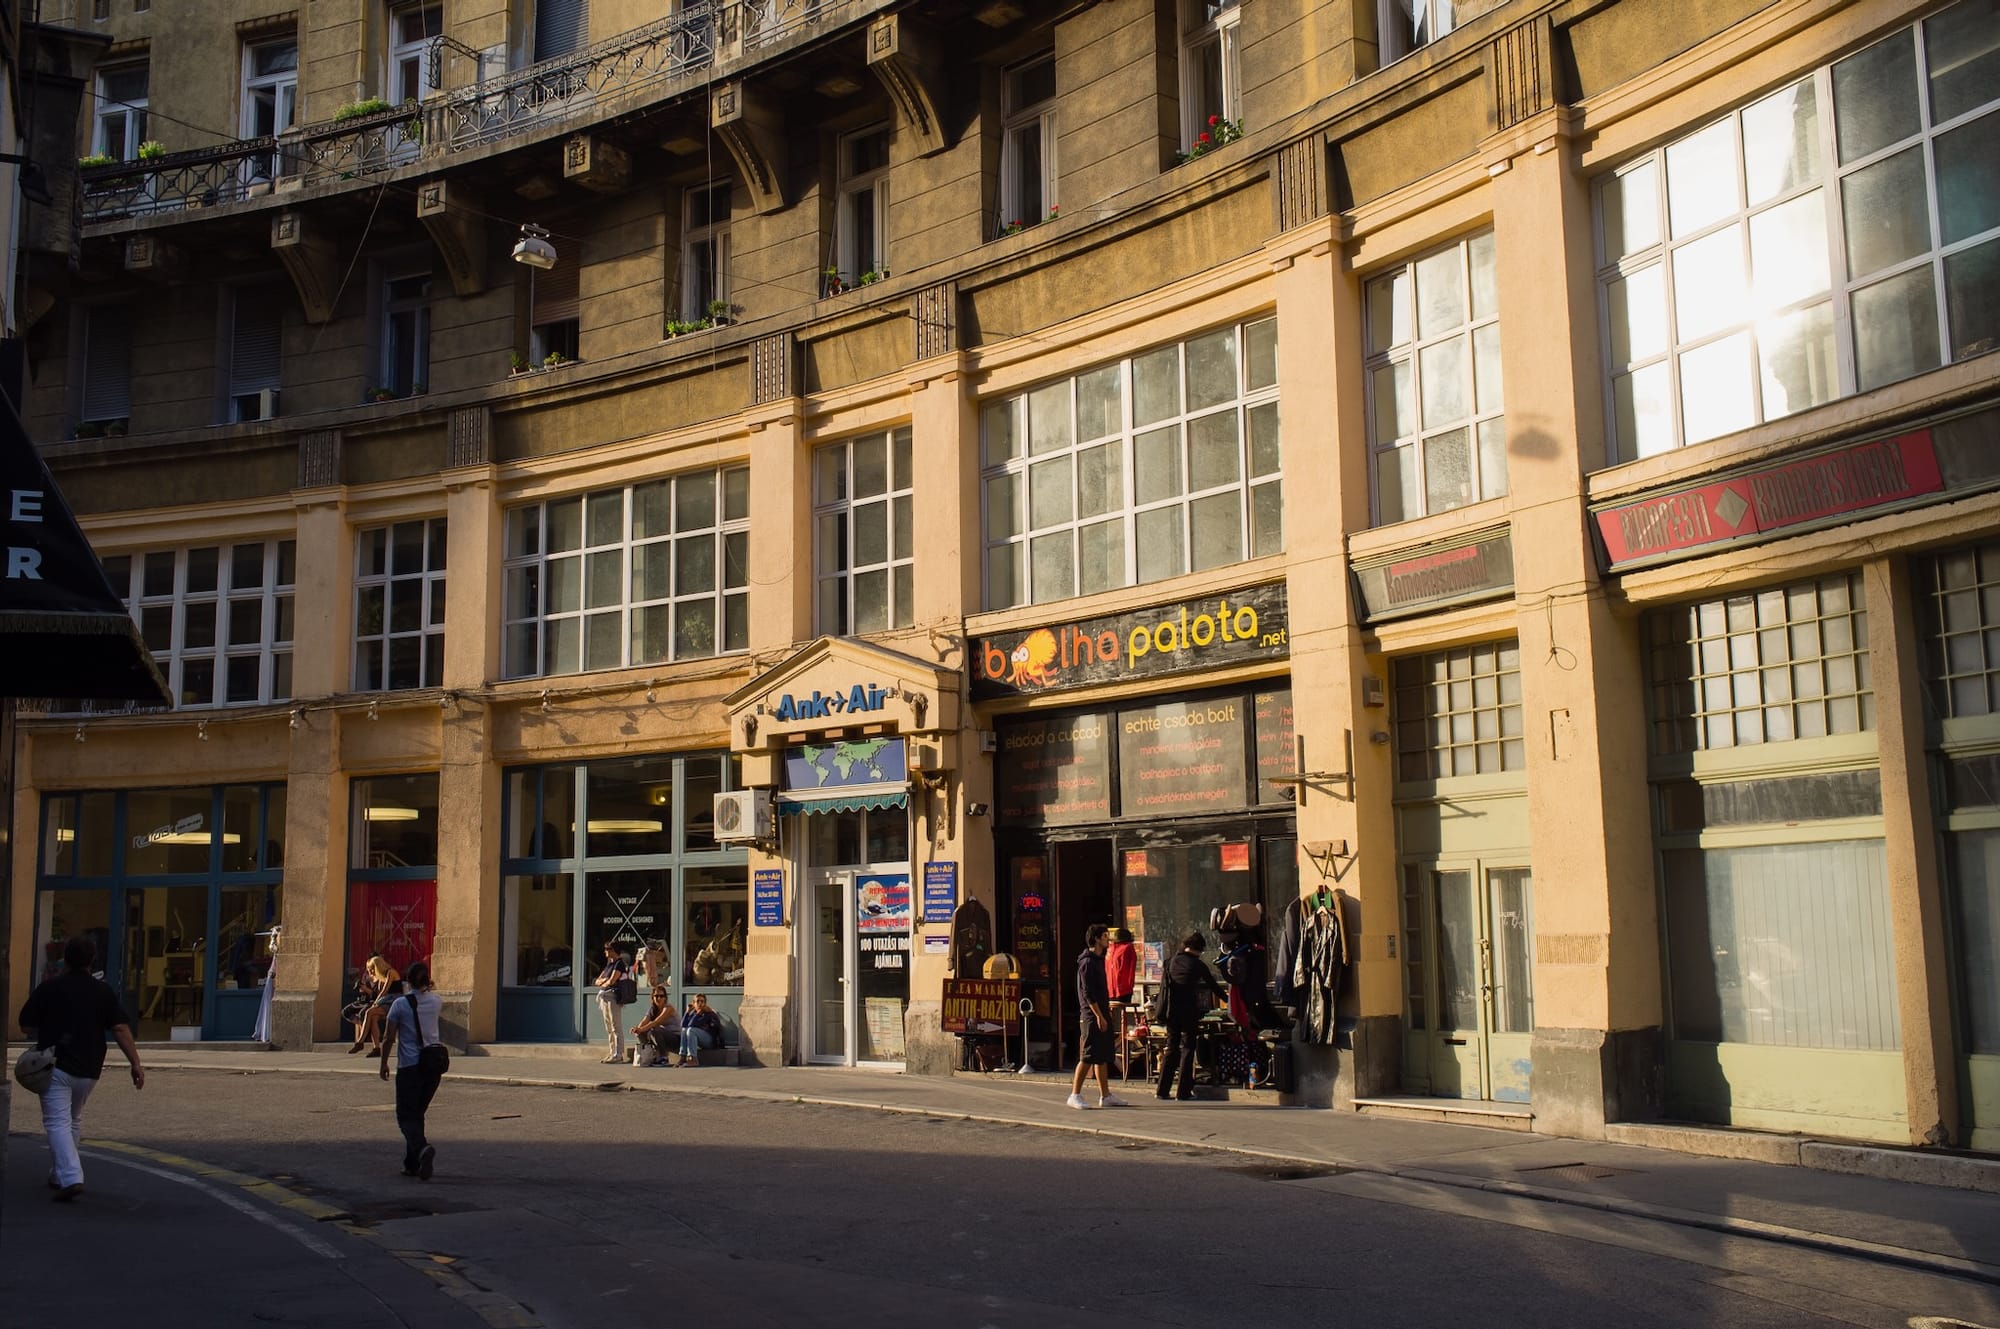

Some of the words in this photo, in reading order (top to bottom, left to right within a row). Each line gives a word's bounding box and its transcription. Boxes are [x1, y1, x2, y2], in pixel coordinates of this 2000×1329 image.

[9, 490, 44, 522] E
[5, 547, 43, 580] R
[1128, 600, 1258, 669] palota
[1259, 631, 1287, 648] .net
[779, 691, 831, 720] Ank
[847, 683, 887, 713] Air
[1125, 716, 1161, 734] echte
[1164, 710, 1204, 729] csoda
[1207, 704, 1235, 724] bolt
[1006, 730, 1044, 749] eladod
[1047, 733, 1055, 744] a
[1058, 723, 1101, 742] cuccod
